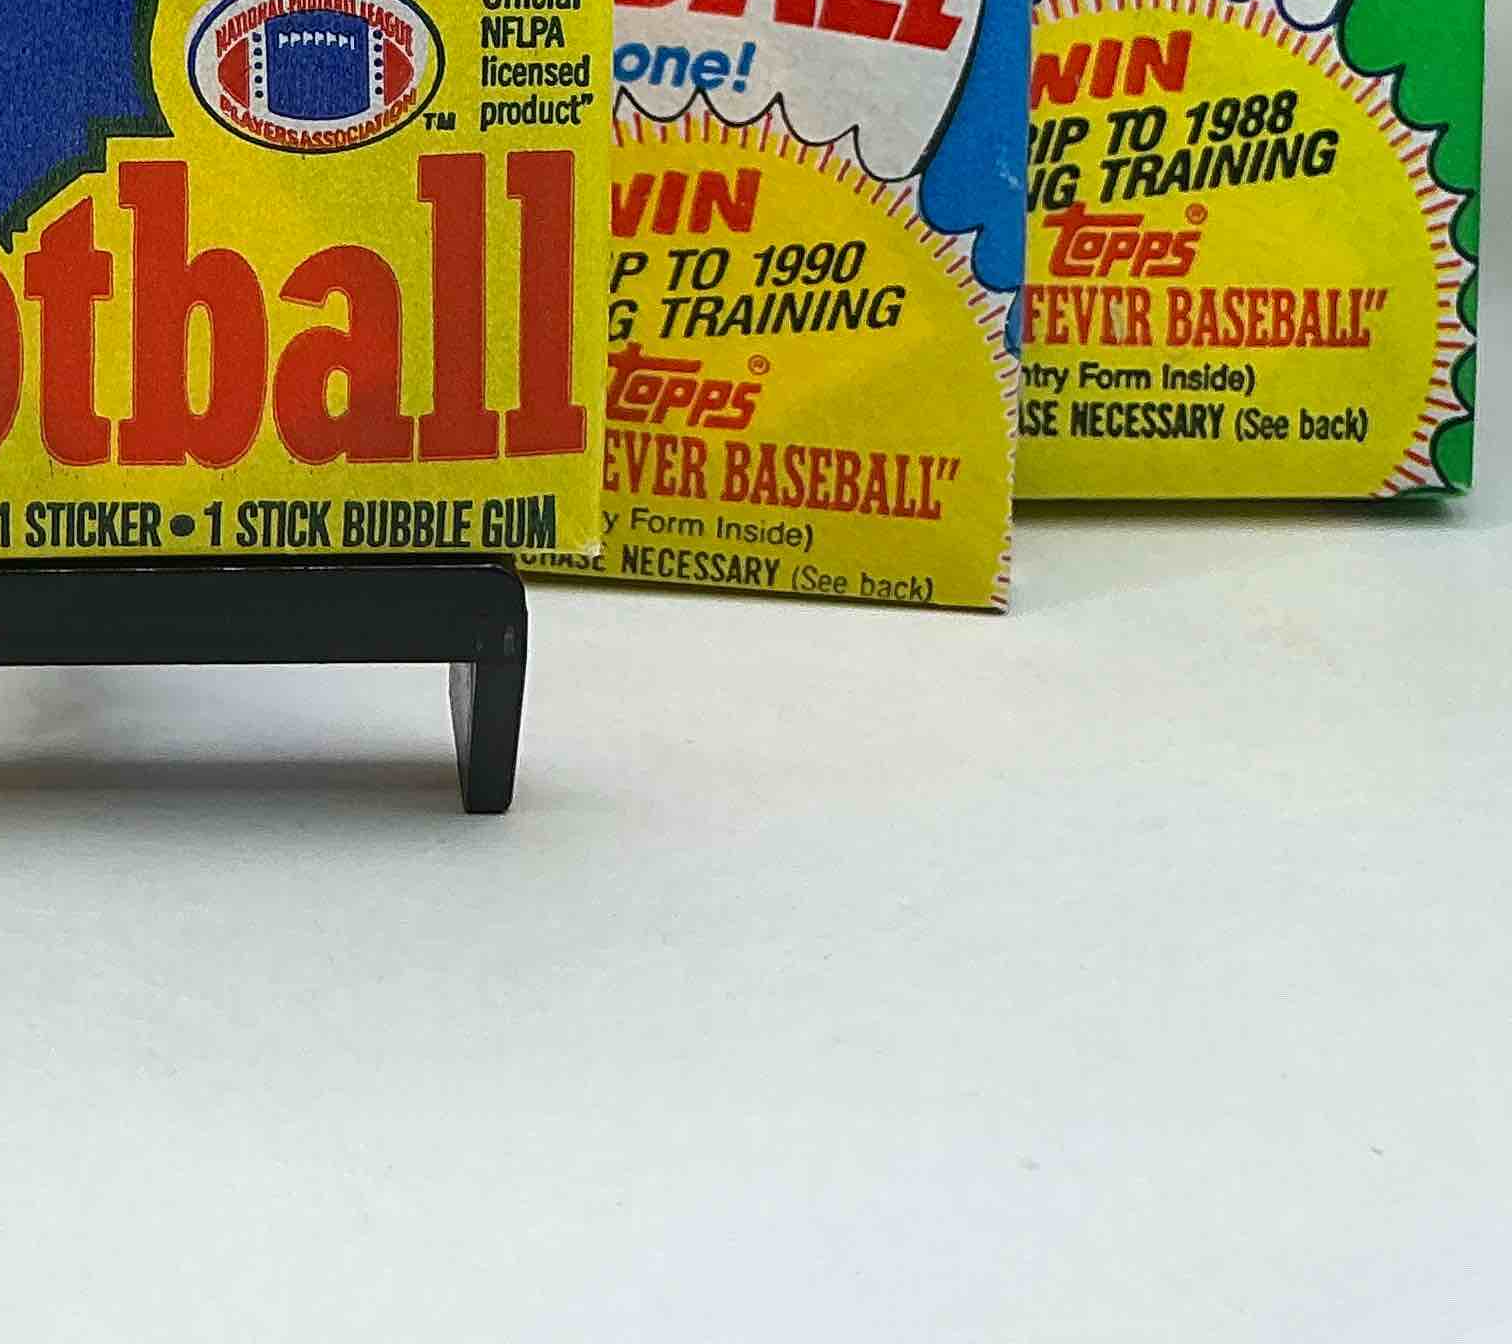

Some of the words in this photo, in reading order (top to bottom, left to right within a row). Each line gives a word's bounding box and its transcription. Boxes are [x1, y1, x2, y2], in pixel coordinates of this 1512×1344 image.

[481, 16, 565, 48] NFLPA
[482, 56, 590, 87] licensed
[614, 41, 756, 92] one!
[219, 94, 297, 145] PLAYERS
[299, 87, 417, 148] ASSOCIATION
[1106, 106, 1166, 156] TO
[1186, 90, 1298, 146] 1988
[1100, 128, 1338, 203] TRAINING
[668, 247, 728, 291] TO
[753, 240, 868, 287] 1990
[660, 286, 906, 338] TRAINING
[1020, 284, 1154, 349] FEVER
[1078, 362, 1152, 391] Form
[1162, 363, 1255, 396] Inside)
[1070, 400, 1225, 440] NECESSARY
[1234, 406, 1288, 442] (See
[1300, 411, 1368, 442] back)
[24, 499, 164, 550] STICKER
[203, 498, 220, 549] 1
[235, 497, 333, 550] STICK
[343, 496, 473, 550] BUBBLE
[482, 495, 557, 550] GUM
[632, 508, 704, 538] Form
[717, 514, 814, 552] Inside)
[621, 546, 780, 587] NECESSARY
[792, 566, 848, 596] (See
[860, 574, 934, 603] back)
